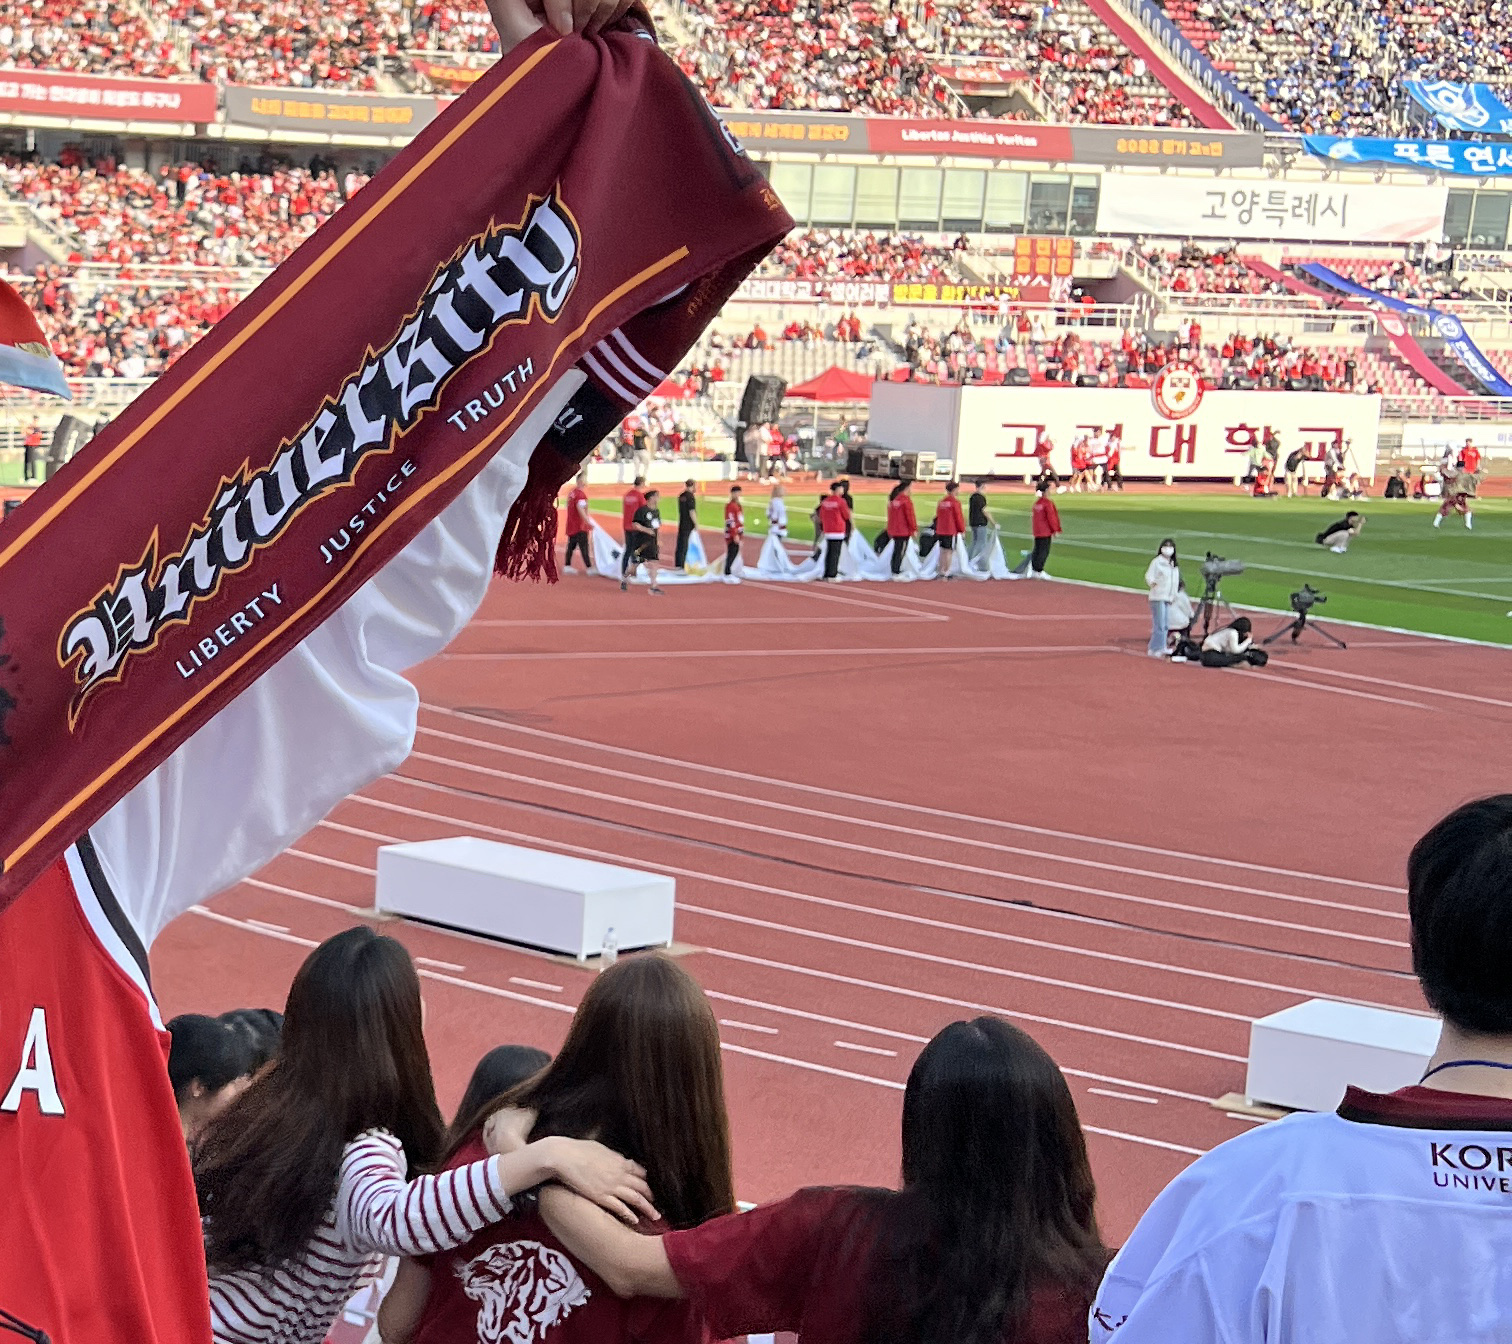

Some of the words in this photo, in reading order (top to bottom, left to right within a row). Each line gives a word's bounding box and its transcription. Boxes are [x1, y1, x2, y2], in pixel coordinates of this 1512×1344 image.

[1201, 189, 1349, 228] 고양특례시
[1393, 143, 1455, 170] 푸른
[62, 192, 581, 711] University
[175, 582, 284, 681] LIBERTY
[317, 457, 418, 565] JUSTICE
[445, 355, 537, 435] TRUTH
